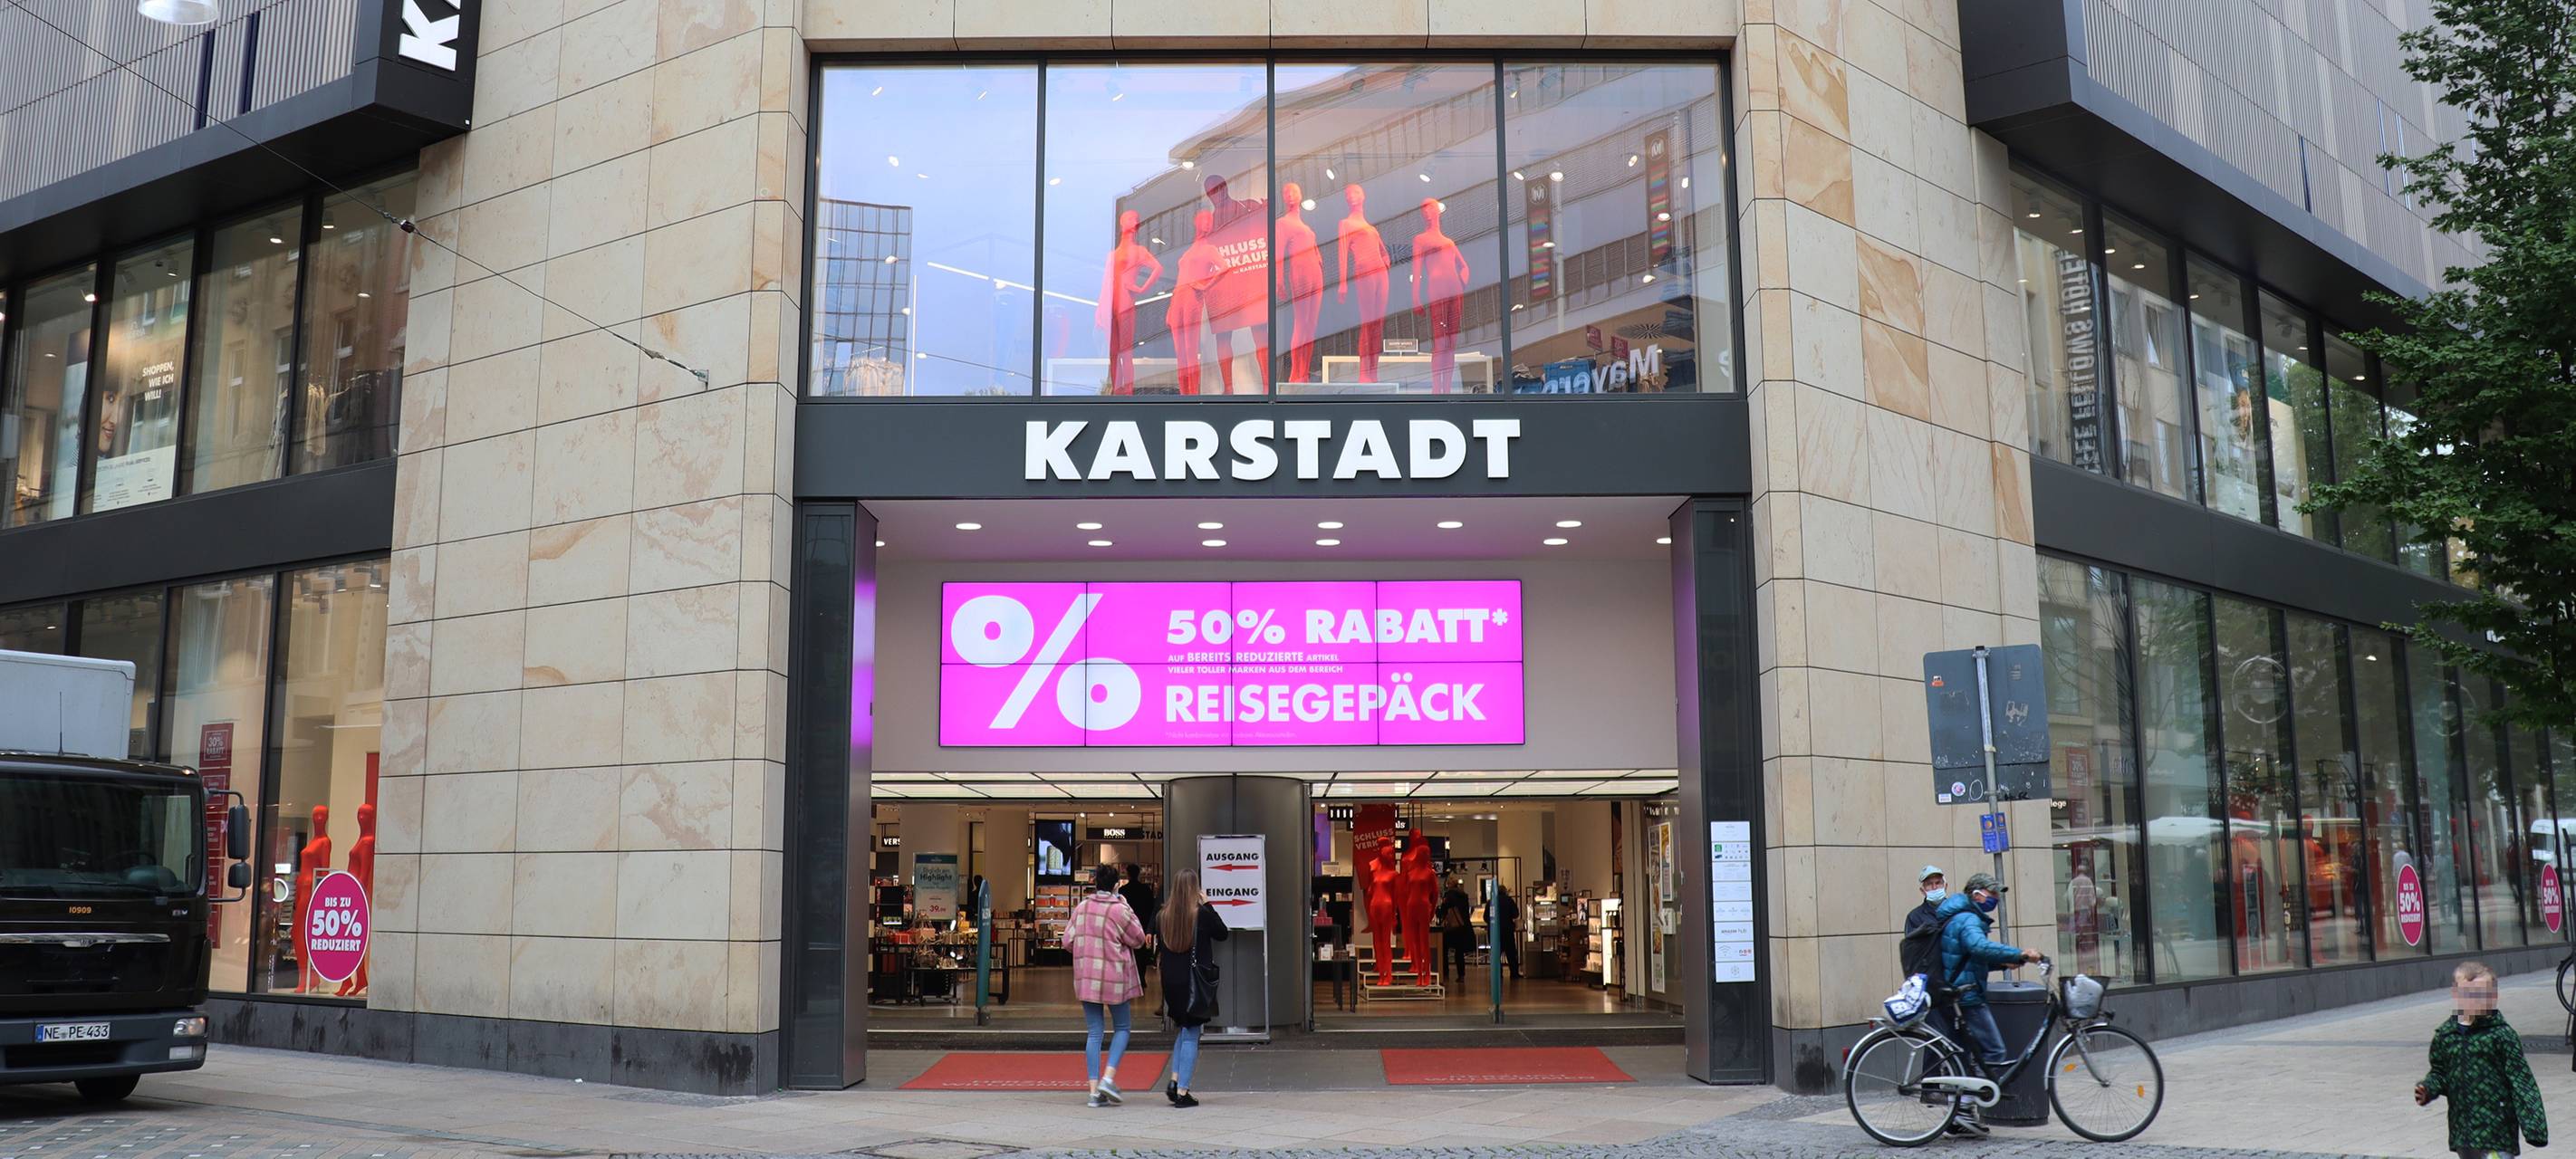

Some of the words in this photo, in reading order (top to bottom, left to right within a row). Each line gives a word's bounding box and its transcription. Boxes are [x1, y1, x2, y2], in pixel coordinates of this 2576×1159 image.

[399, 0, 461, 71] K
[1217, 238, 1267, 257] HLUSS
[1226, 252, 1268, 269] RKAUF
[142, 361, 175, 377] SHOPPEN,
[149, 377, 161, 388] WIE
[162, 373, 174, 385] ICH
[144, 389, 161, 401] WILL!
[1024, 419, 1522, 481] KARSTADT
[1167, 608, 1286, 645] 50%
[1168, 655, 1185, 663] AUF
[1187, 652, 1231, 662] BEREITS
[1235, 652, 1304, 662] REDUZIERTE
[1306, 654, 1340, 662] ARTIKEL
[1166, 672, 1487, 723] REISEGEPÄCK
[208, 737, 224, 747] 30%
[1103, 829, 1126, 837] BOSS
[1354, 828, 1395, 842] SCHLUSS
[1355, 836, 1396, 850] VERKF
[1206, 852, 1260, 861] AUSGANG
[919, 873, 953, 882] Highlight
[1206, 887, 1259, 896] EINGANG
[2543, 886, 2560, 905] 50%
[325, 897, 338, 907] BIS
[340, 897, 351, 907] ZU
[2399, 892, 2421, 913] 50%
[312, 909, 362, 937] 50%
[311, 939, 361, 952] REDUZIERT
[44, 1028, 61, 1040] NE
